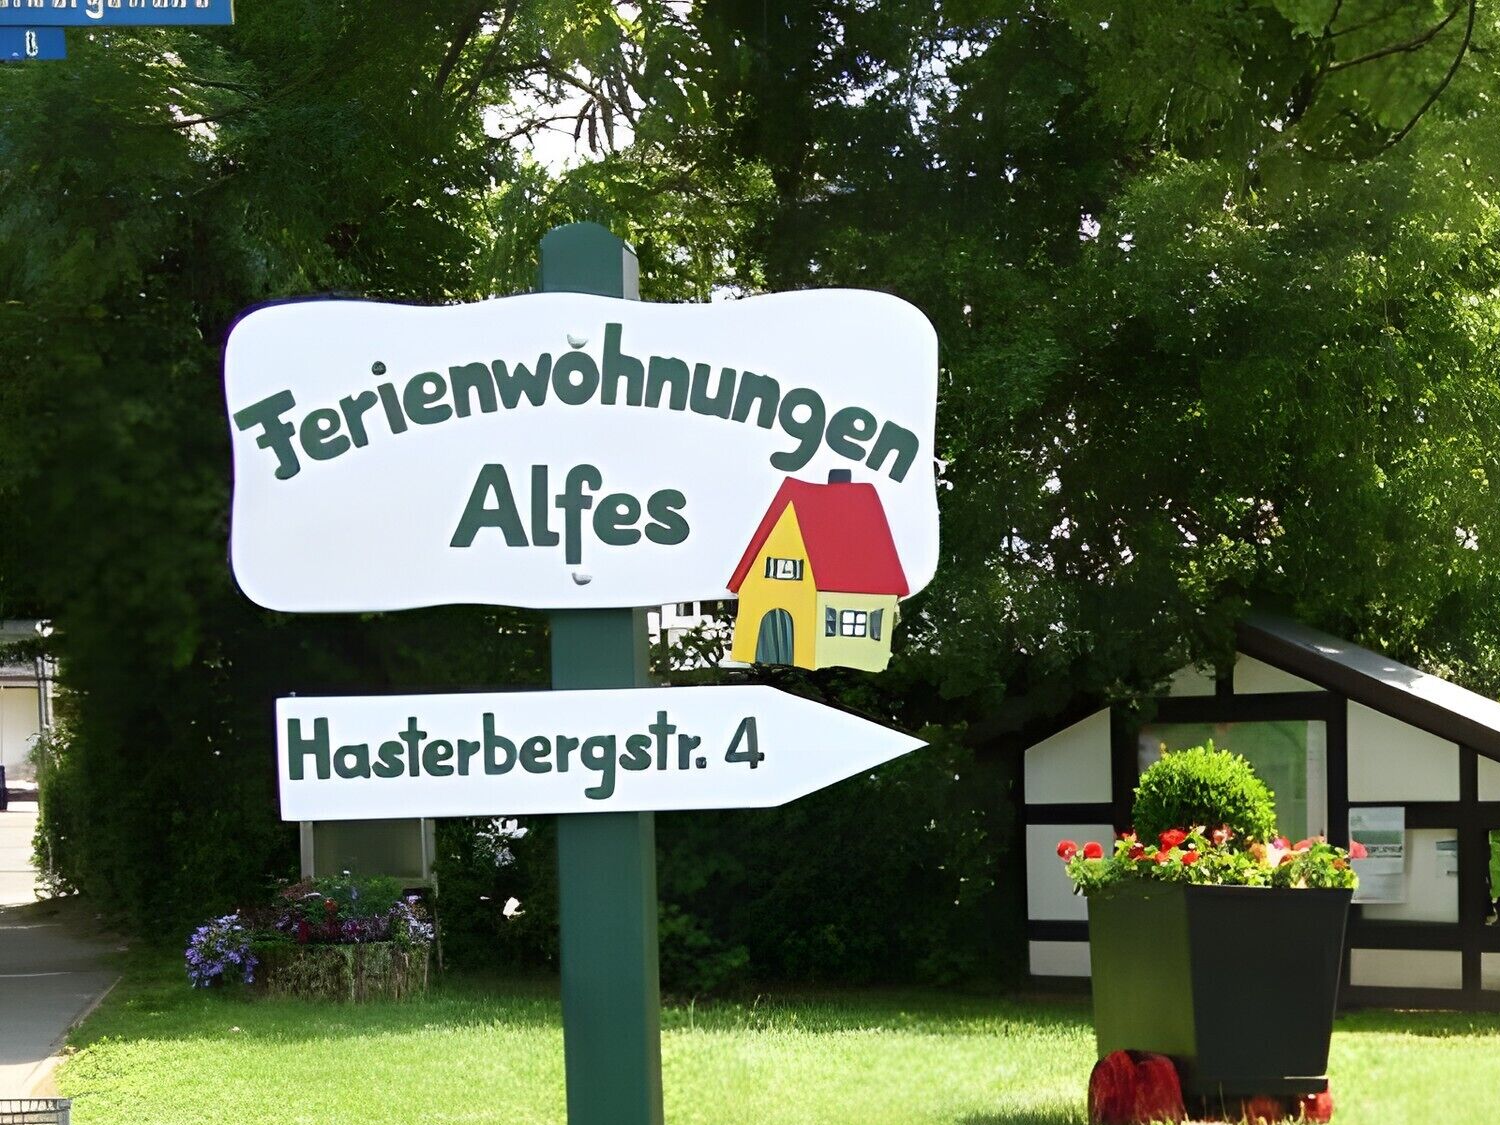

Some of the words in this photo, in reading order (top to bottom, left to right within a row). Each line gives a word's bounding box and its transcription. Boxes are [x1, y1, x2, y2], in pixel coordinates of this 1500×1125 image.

[234, 323, 919, 483] Ferienwohnungen
[450, 464, 689, 565] Alfes
[287, 711, 707, 801] Hasterbergstr.
[724, 716, 765, 770] 4
